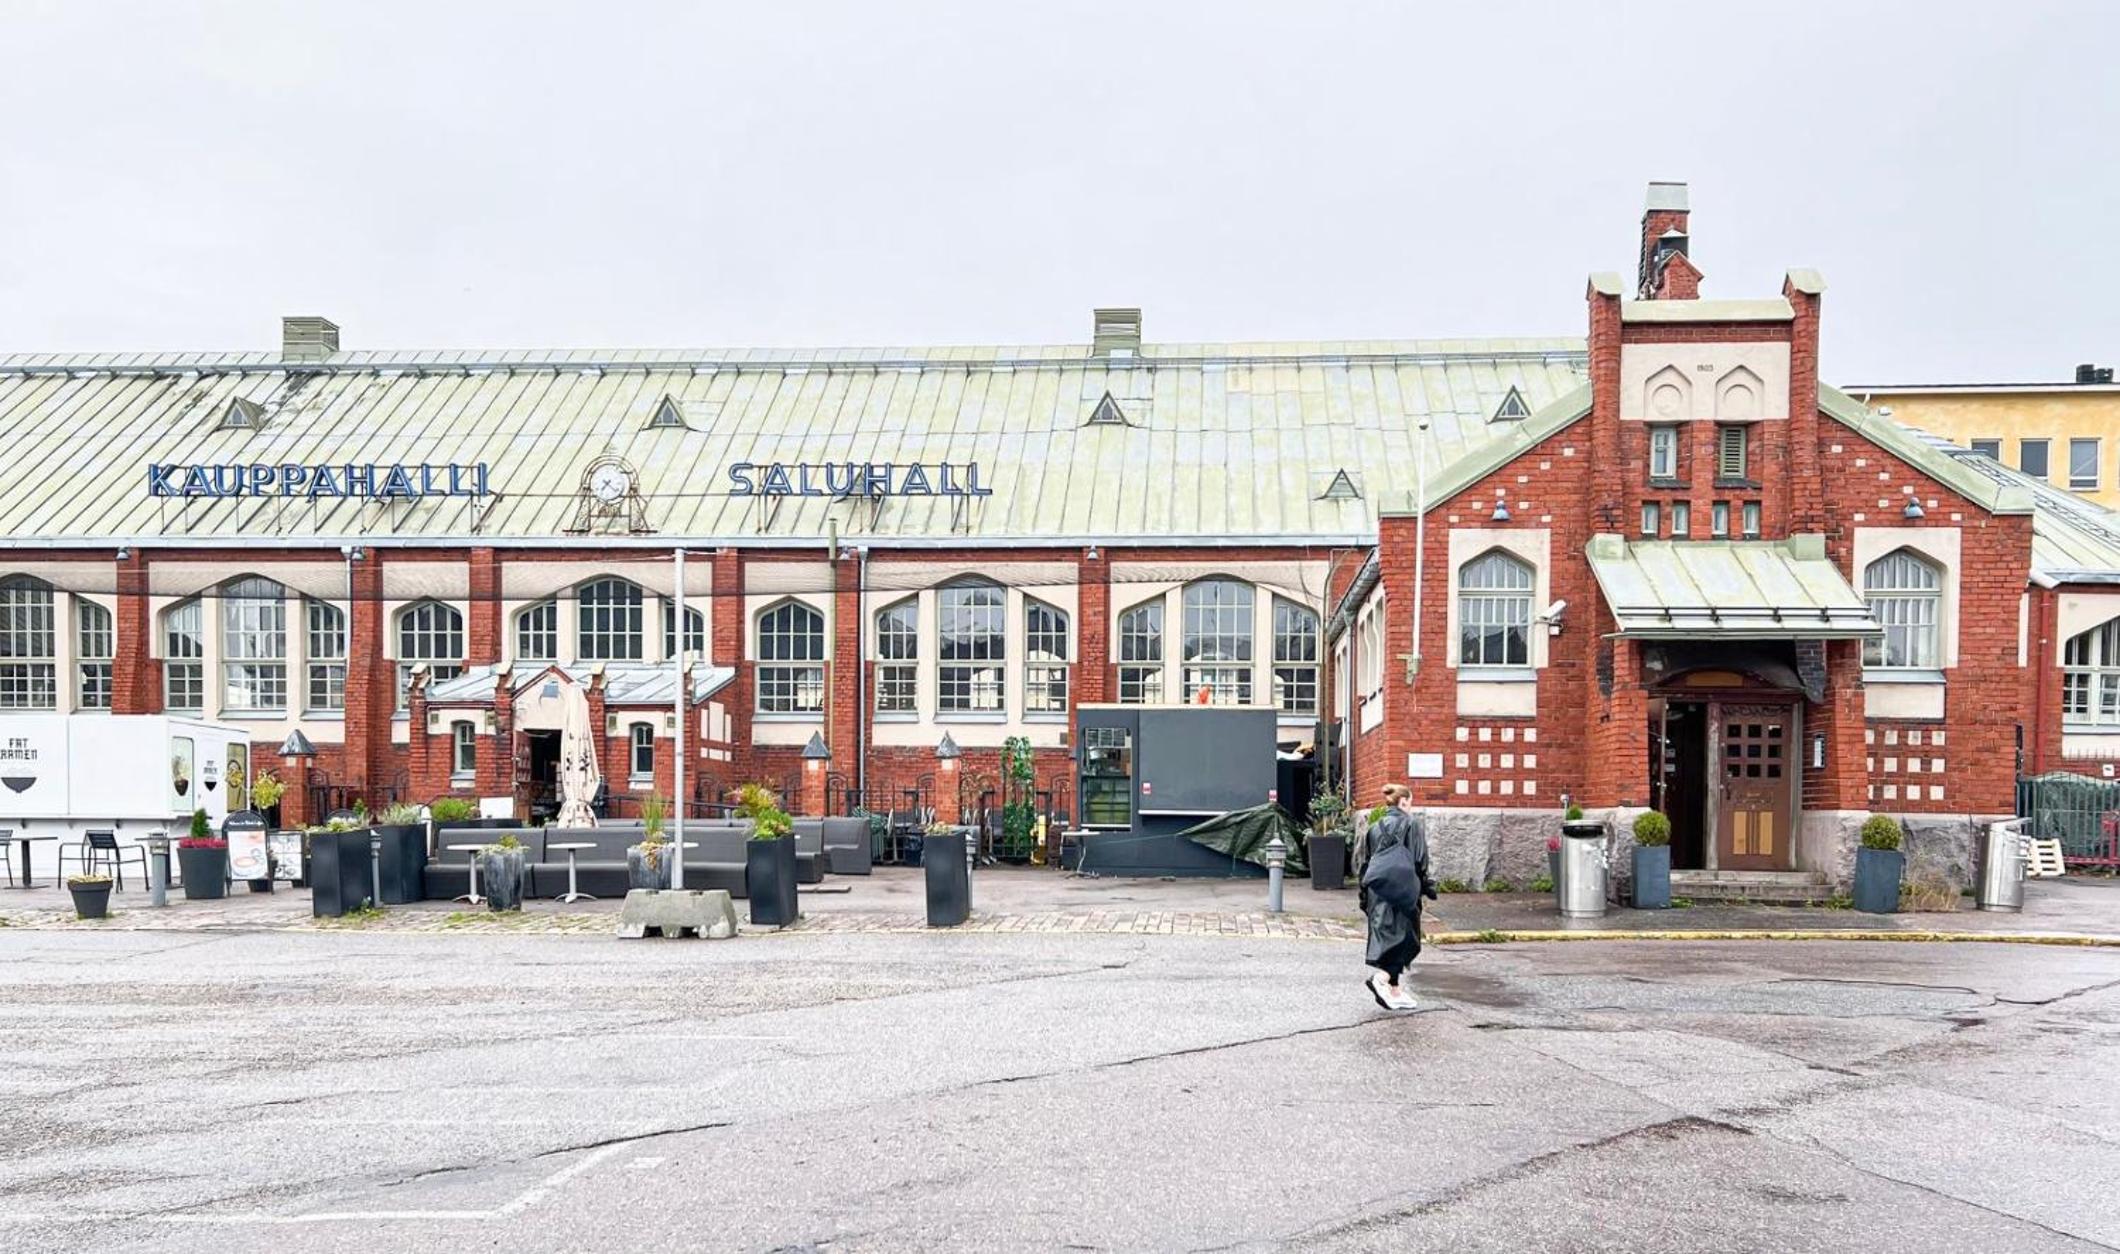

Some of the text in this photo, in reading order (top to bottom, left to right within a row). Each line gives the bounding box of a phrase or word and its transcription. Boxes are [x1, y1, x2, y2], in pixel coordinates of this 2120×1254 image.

[148, 462, 489, 498] KAUPPAHALLI
[728, 461, 993, 497] SALUHALL
[9, 738, 28, 748] FAT
